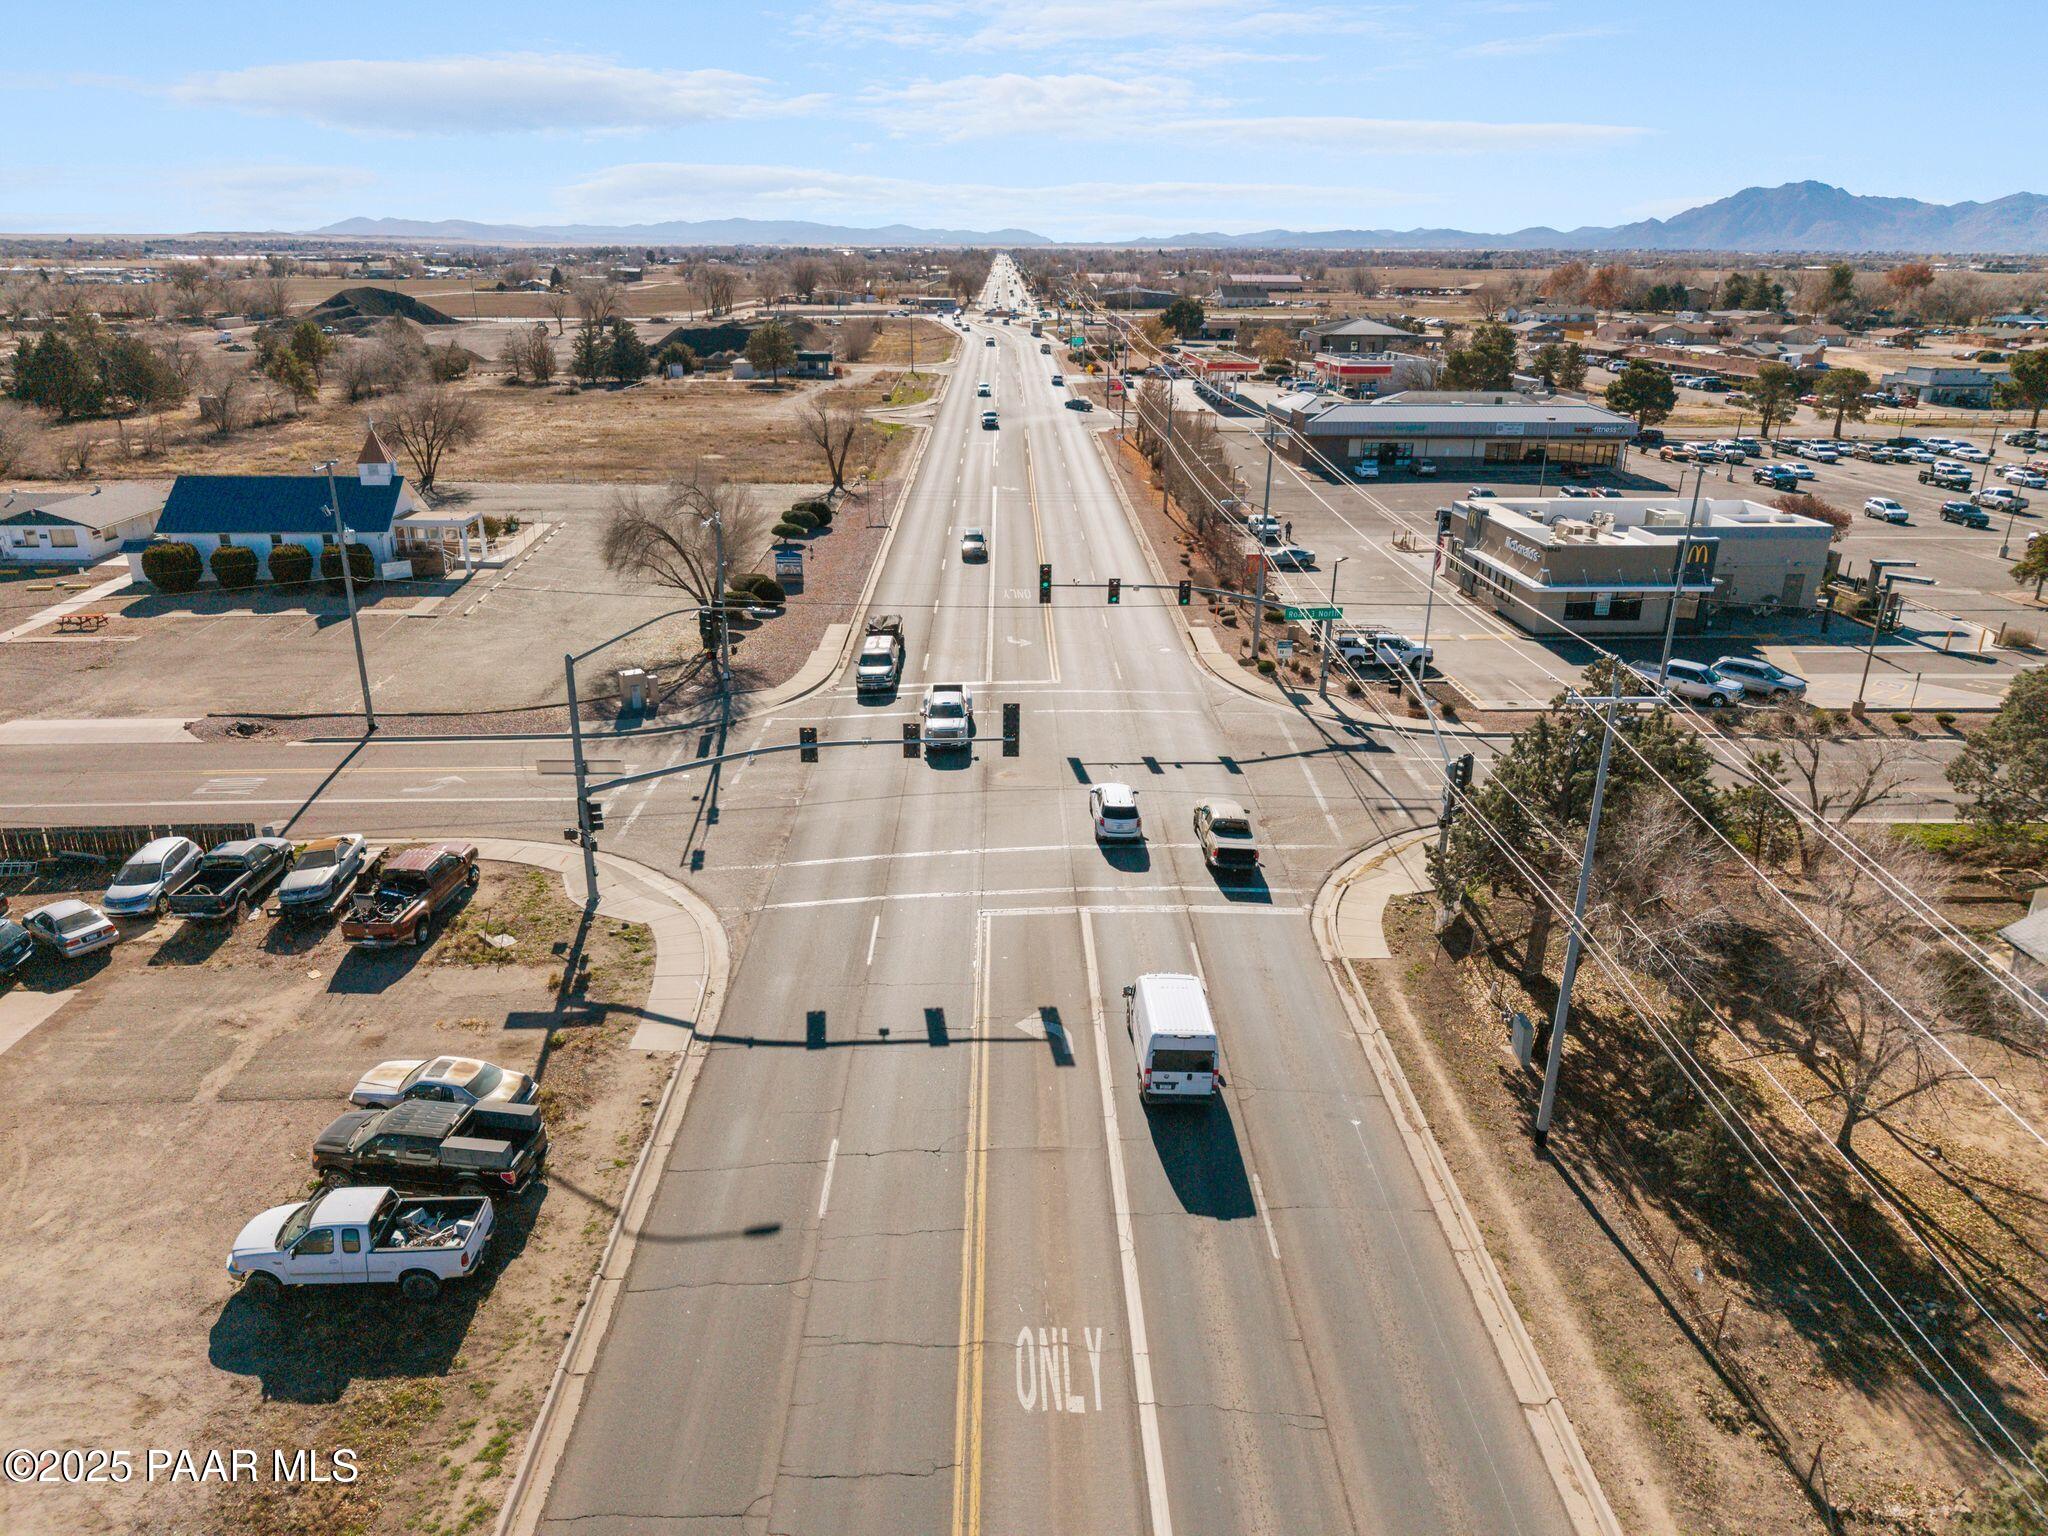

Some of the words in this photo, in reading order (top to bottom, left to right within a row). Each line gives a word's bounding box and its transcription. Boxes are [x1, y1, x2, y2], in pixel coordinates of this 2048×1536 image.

[1003, 588, 1032, 600] ONLY
[1318, 609, 1339, 617] North
[1015, 1326, 1102, 1414] ONLY
